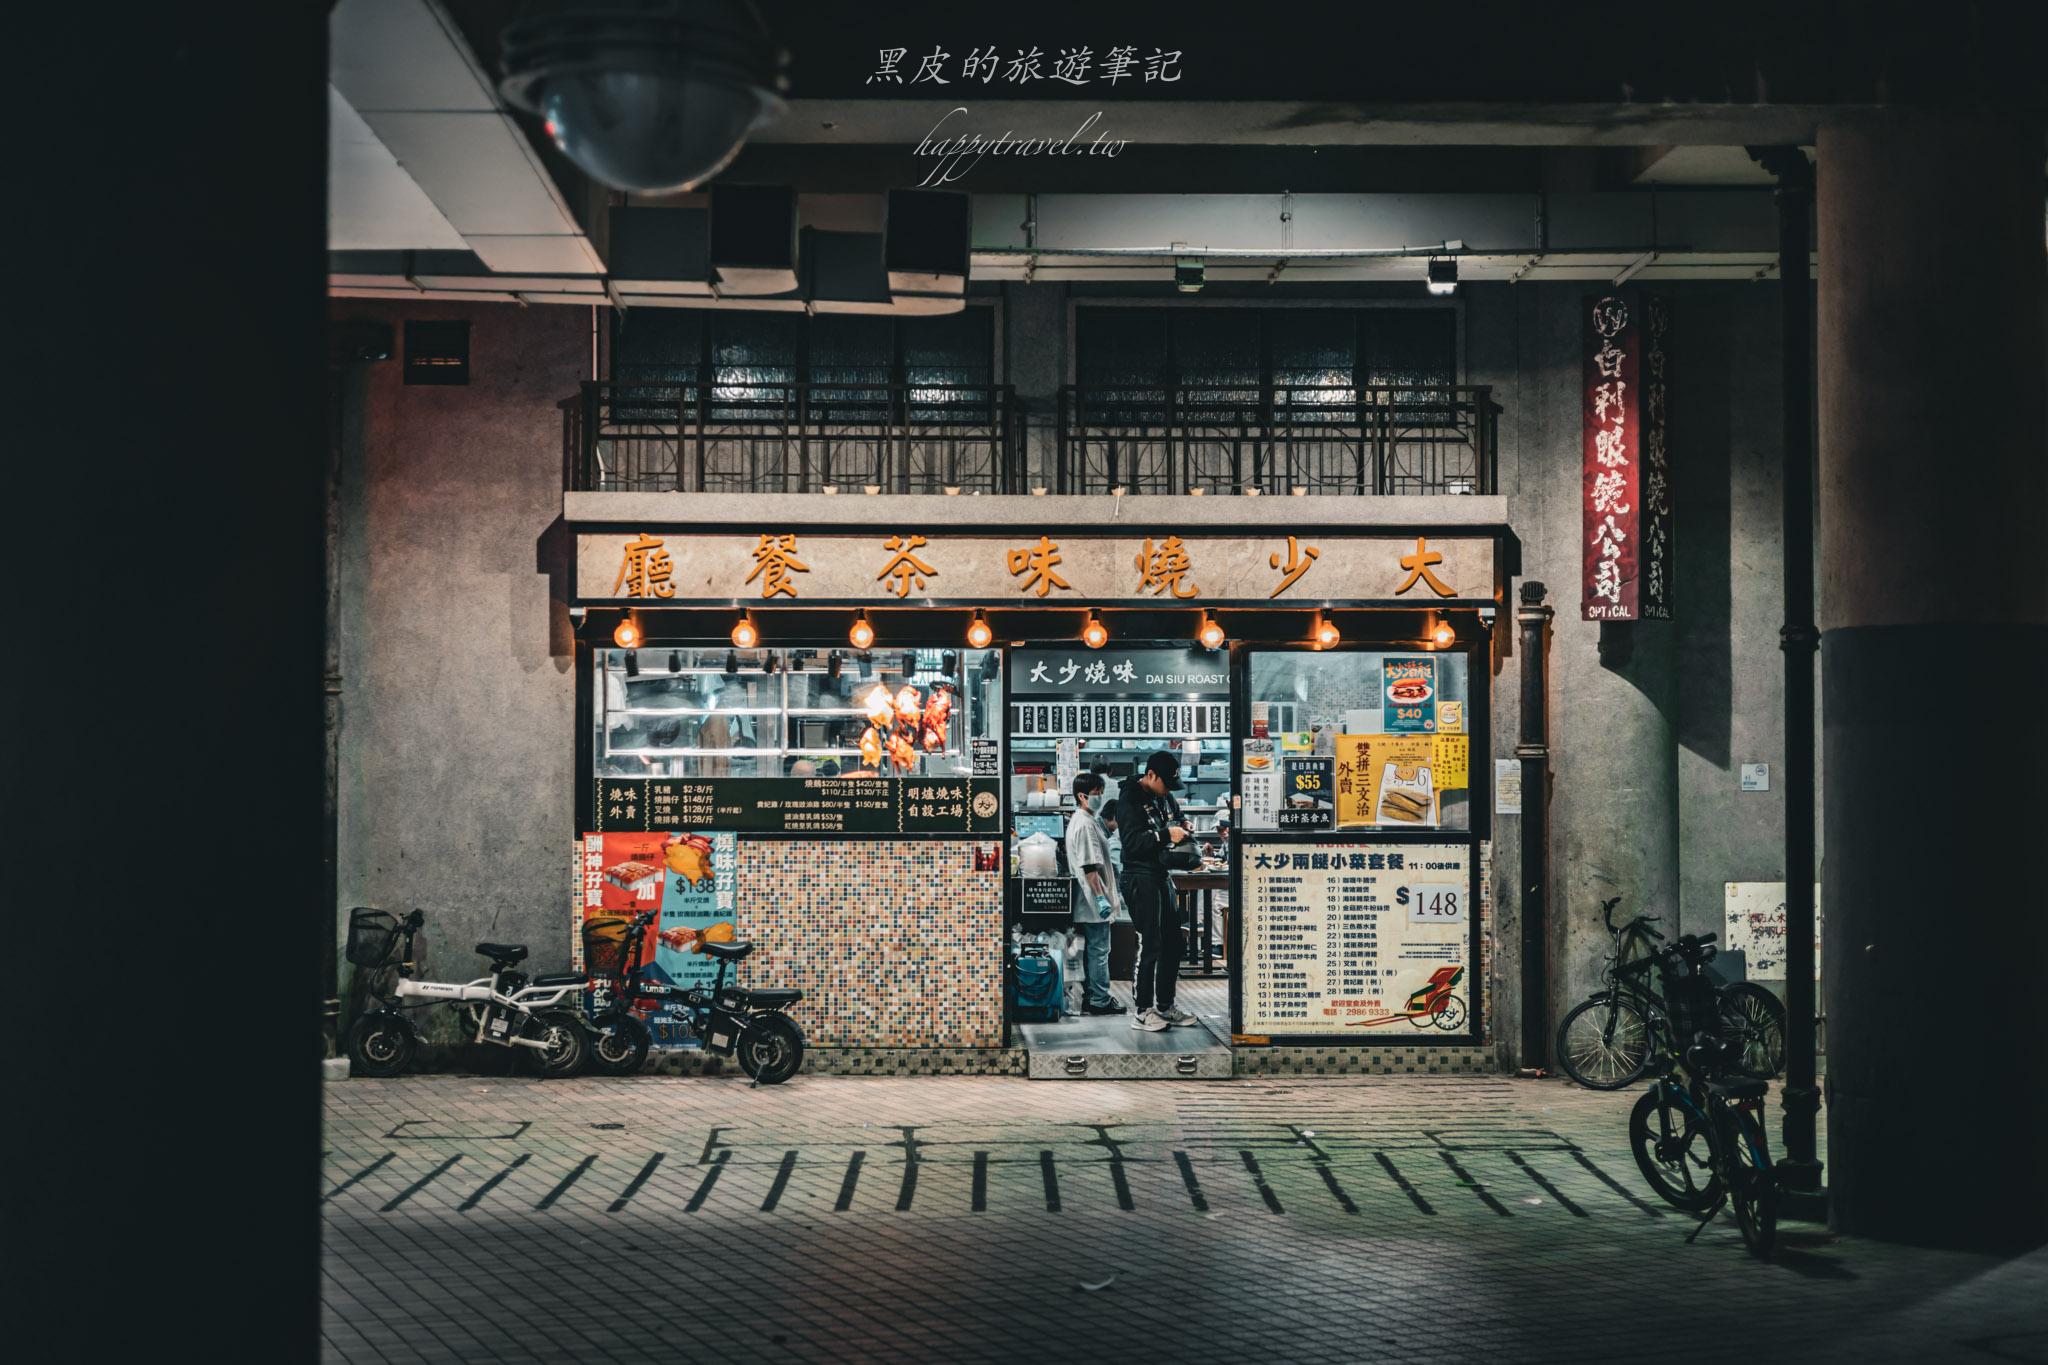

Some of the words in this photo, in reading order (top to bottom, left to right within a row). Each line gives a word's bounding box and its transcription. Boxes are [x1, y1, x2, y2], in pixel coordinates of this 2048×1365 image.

[613, 533, 1459, 598] 大少燒味茶餐廳
[1588, 604, 1632, 618] OPTICAL
[1030, 658, 1139, 685] 大少燒味
[1146, 674, 1164, 684] DAI
[1166, 674, 1185, 684] SIU
[1187, 674, 1225, 684] ROAST
[1295, 774, 1321, 790] $55
[1338, 760, 1354, 795] 外賣
[1355, 741, 1371, 816] 雙拼三文治
[608, 787, 638, 801] 燒味
[682, 795, 714, 804] $148/斤
[907, 786, 964, 800] 明爐燒味
[608, 805, 637, 819] 外賣
[682, 805, 714, 814] $128/斤
[907, 803, 963, 817] 自設工場
[682, 815, 714, 824] $128/斤
[715, 833, 734, 909] 燒味孖寶
[636, 881, 655, 900] 加
[676, 877, 716, 895] $138
[1346, 1008, 1367, 1016] 2986
[1369, 1008, 1390, 1016] 9333
